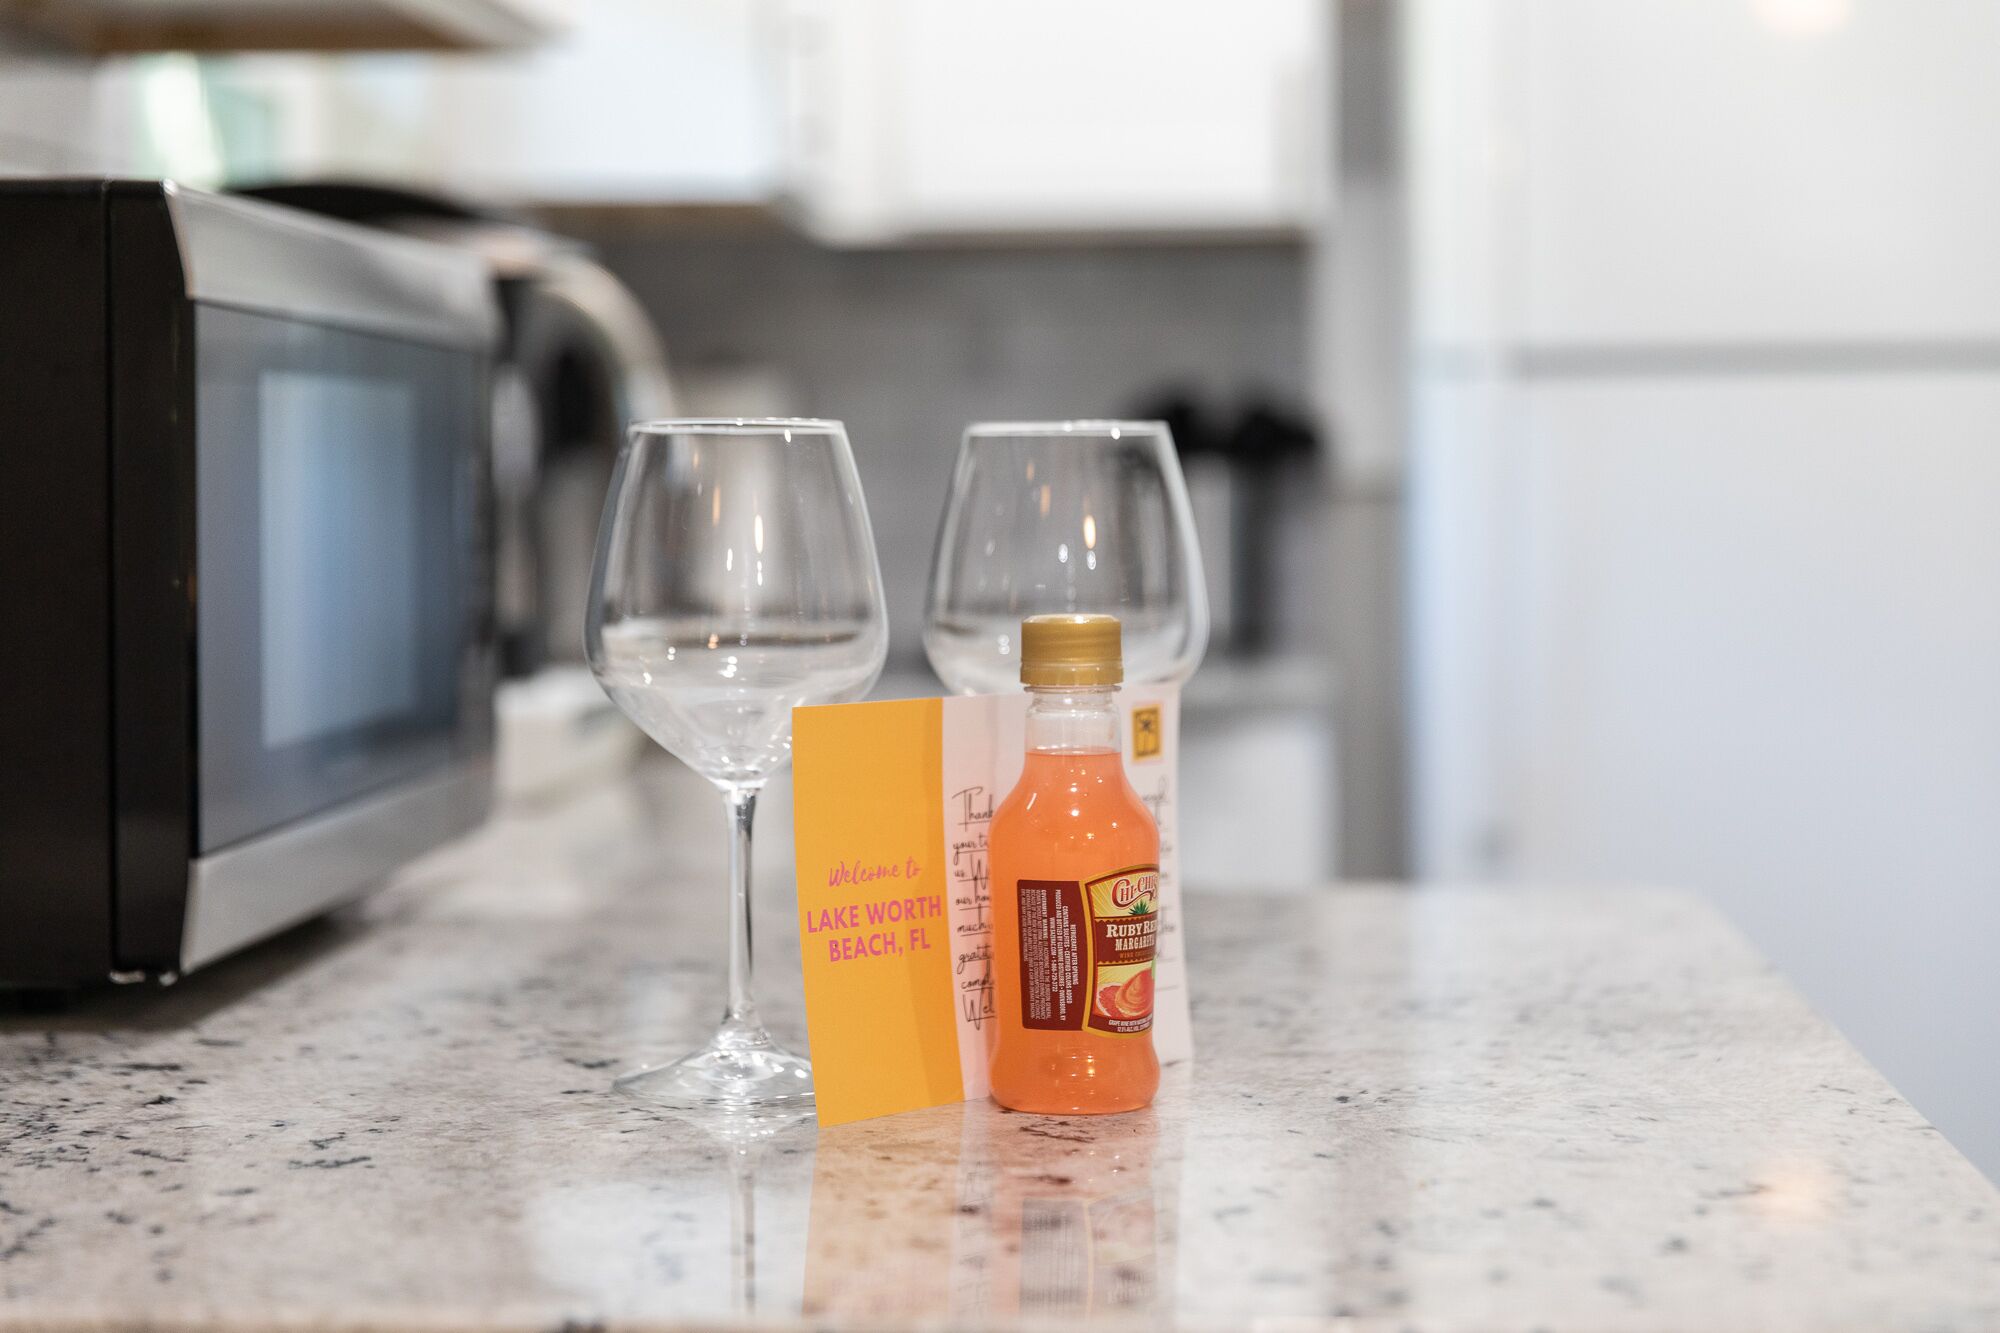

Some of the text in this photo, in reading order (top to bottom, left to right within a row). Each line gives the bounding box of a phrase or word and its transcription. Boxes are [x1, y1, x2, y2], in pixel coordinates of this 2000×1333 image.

[828, 856, 922, 887] Welcome to
[807, 895, 942, 933] LAKE WORTH
[829, 928, 931, 962] BEACH, FL
[1106, 923, 1142, 938] RUBY
